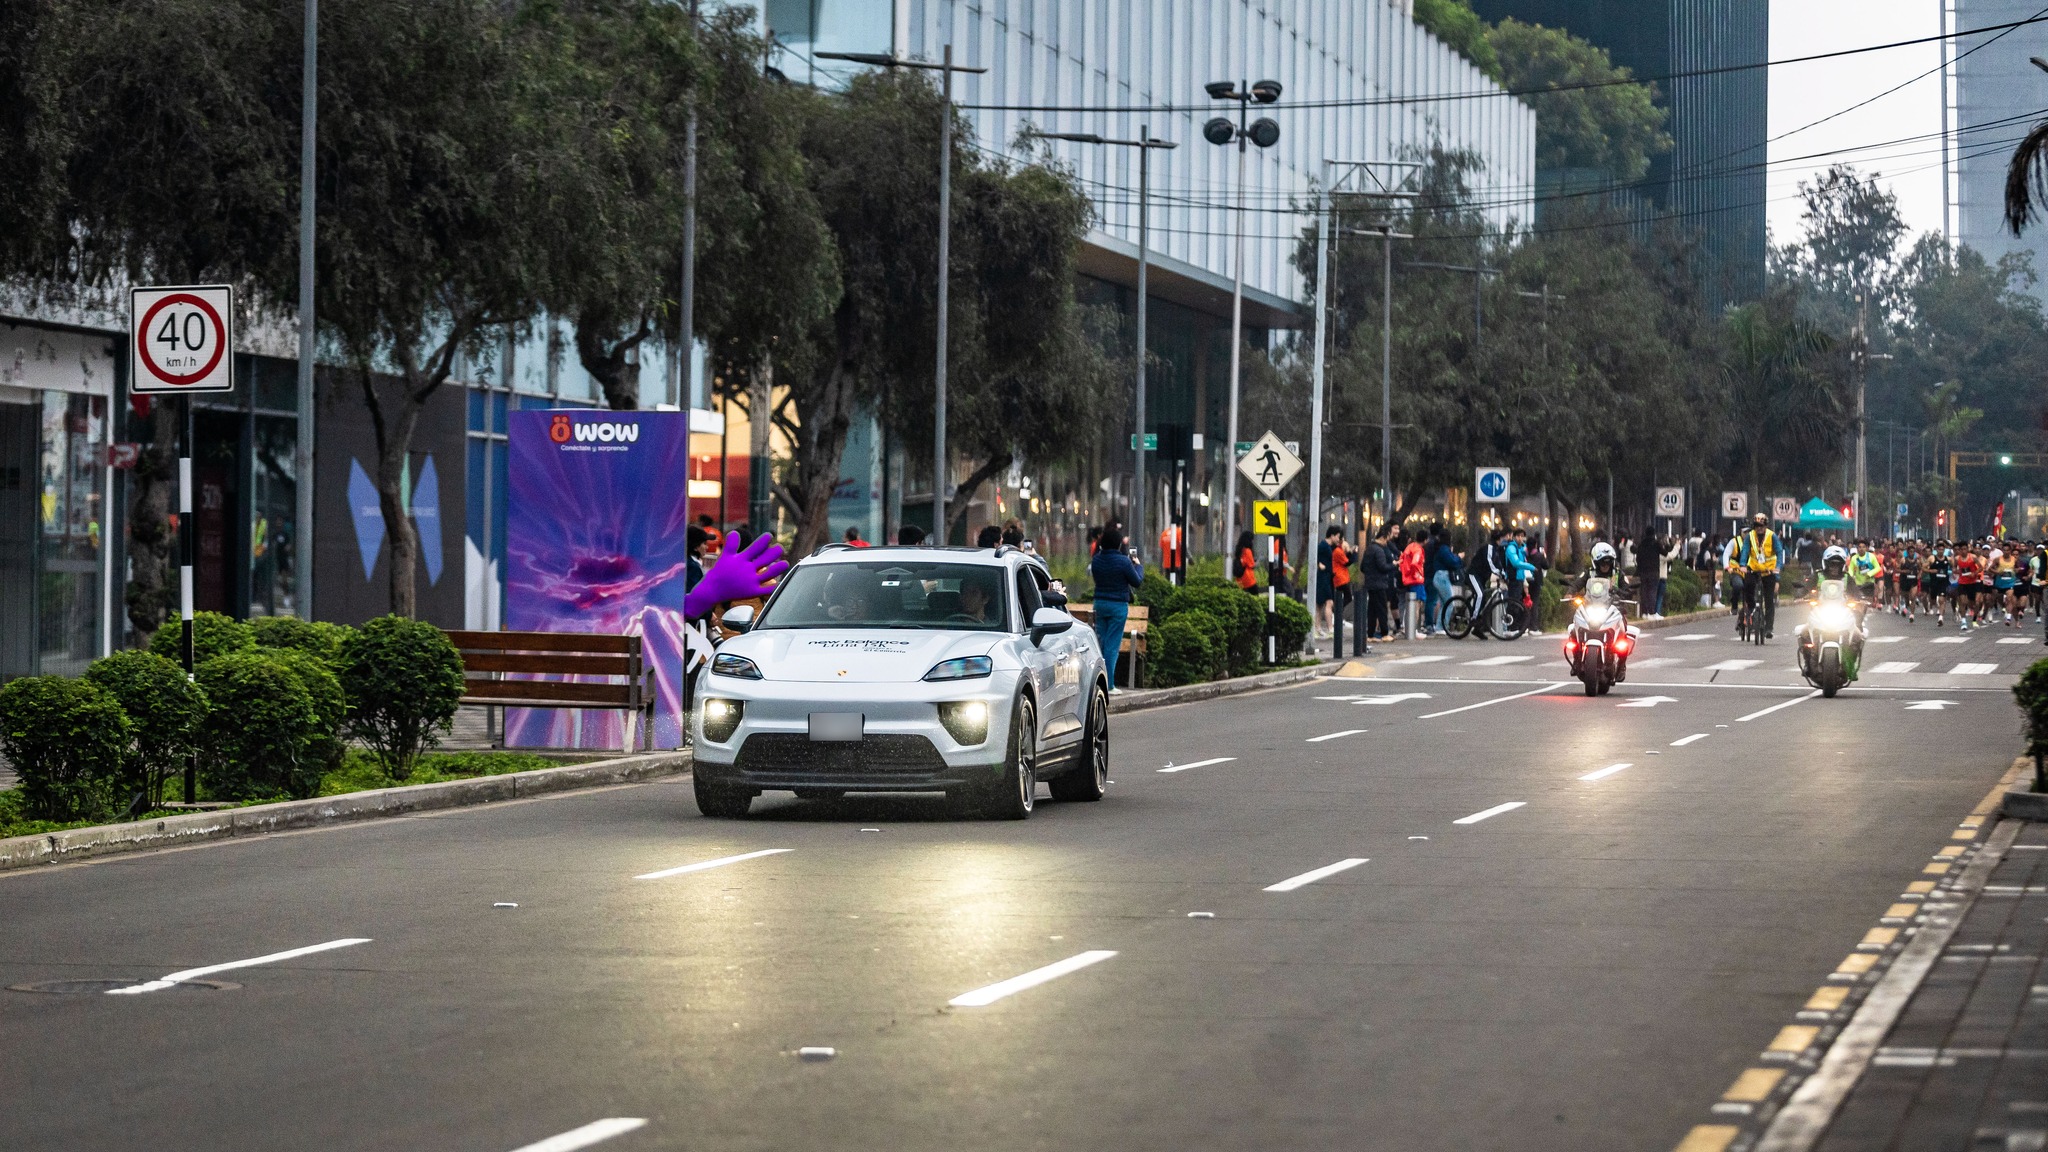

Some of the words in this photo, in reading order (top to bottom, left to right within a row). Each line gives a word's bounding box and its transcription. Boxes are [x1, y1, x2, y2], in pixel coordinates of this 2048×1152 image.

[157, 312, 205, 351] 40
[574, 422, 639, 442] WOW
[1663, 494, 1677, 505] 40
[1779, 502, 1789, 511] 40
